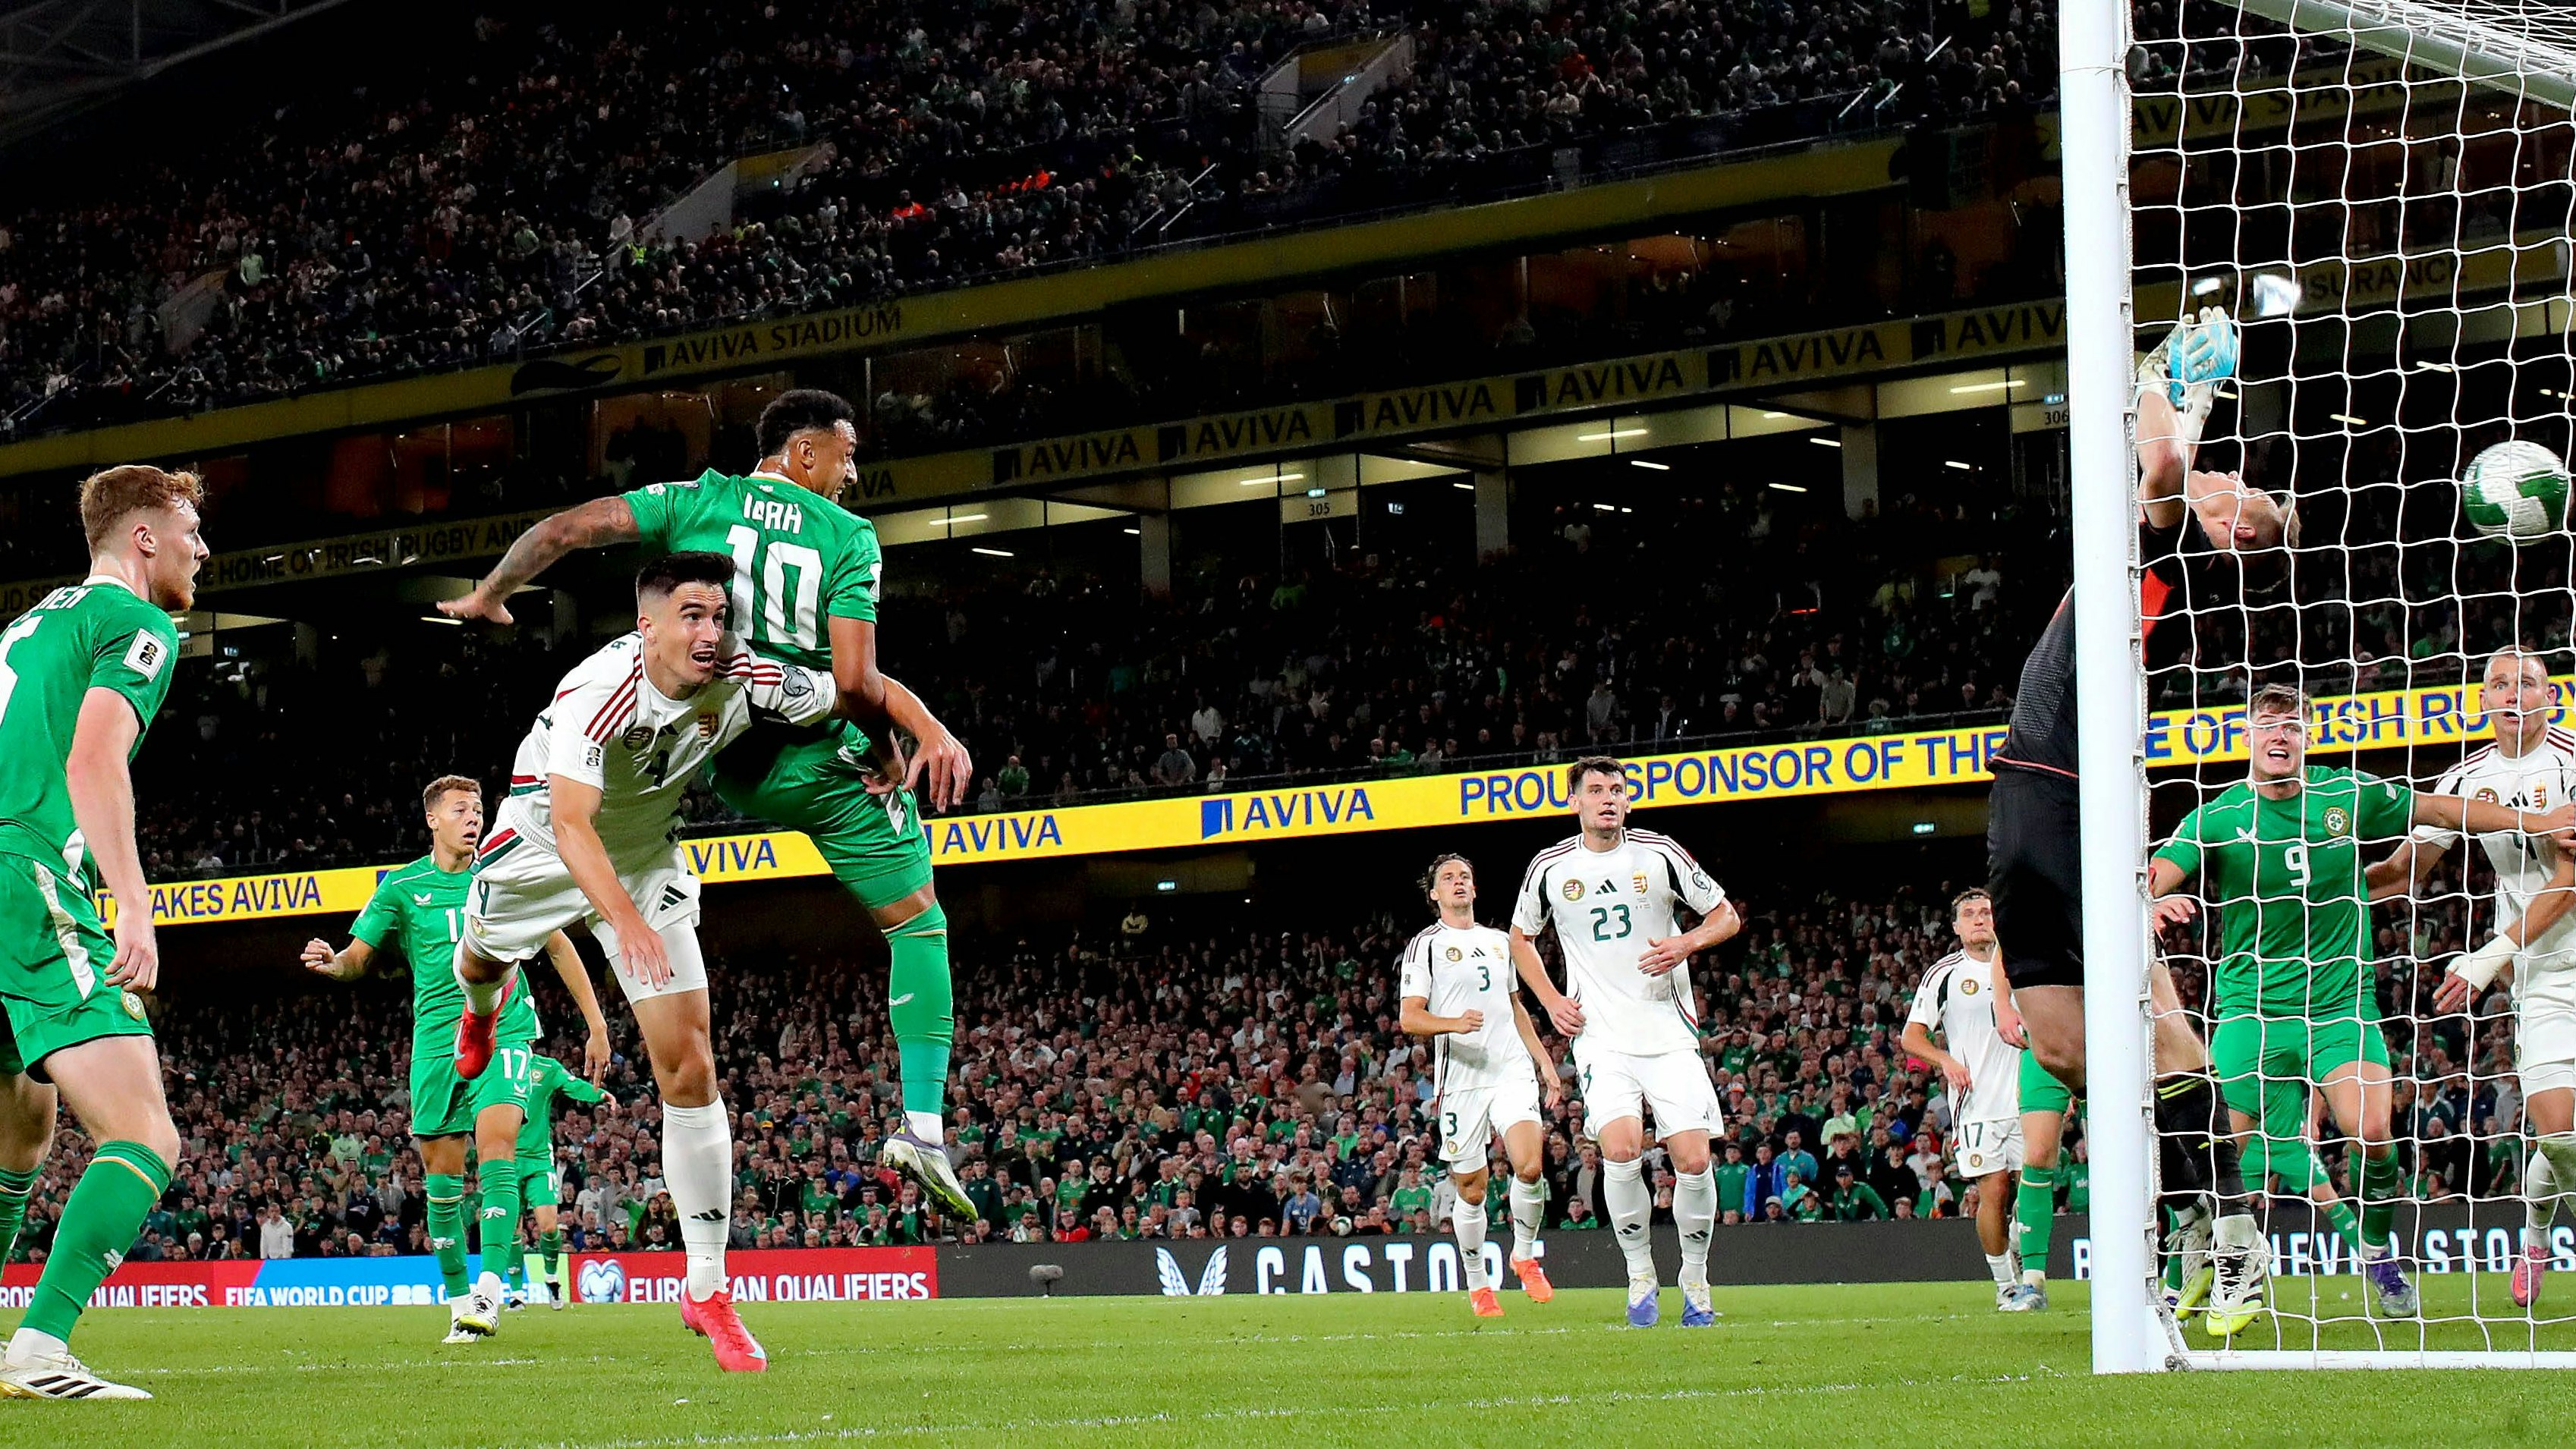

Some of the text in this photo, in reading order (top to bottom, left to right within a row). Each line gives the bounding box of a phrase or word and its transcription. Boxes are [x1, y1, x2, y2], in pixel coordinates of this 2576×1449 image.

[2133, 94, 2249, 133] AVVA
[672, 308, 901, 366] AVIVA STADIUM
[1958, 303, 2064, 347] AVIV
[1751, 331, 1883, 377] AVIVA
[1557, 358, 1684, 404] AVIVA
[1375, 385, 1495, 428] AVIVA
[1197, 410, 1311, 454] AVIVA
[1029, 435, 1137, 475] AVIVA
[849, 470, 896, 501] IVA
[1309, 503, 1330, 516] 305
[400, 527, 478, 562] RUGBY
[725, 524, 823, 651] 10
[2184, 715, 2243, 754] OF
[2317, 696, 2405, 743] ISH
[1461, 771, 1570, 816] PROU
[1625, 746, 1832, 802] SPONSOR
[1845, 740, 1904, 782] OF
[1243, 788, 1374, 830] AVIVA
[942, 814, 1062, 855] AVIVA
[689, 838, 777, 873] VIVA
[2285, 845, 2311, 887] 9
[149, 884, 223, 919] AKES
[231, 876, 322, 913] AVIVA
[1590, 904, 1632, 941] 23
[1477, 966, 1490, 992] 3
[500, 1048, 527, 1080] 17
[1445, 1112, 1458, 1136] 3
[1964, 1122, 1983, 1149] 17
[1255, 1240, 1546, 1295] CASTOR
[2426, 1225, 2576, 1275] STOS
[225, 1287, 264, 1306] FIFA
[269, 1286, 344, 1306] WORLD
[347, 1285, 386, 1306] CUP
[629, 1272, 929, 1303] EURAN QUALIFIERS
